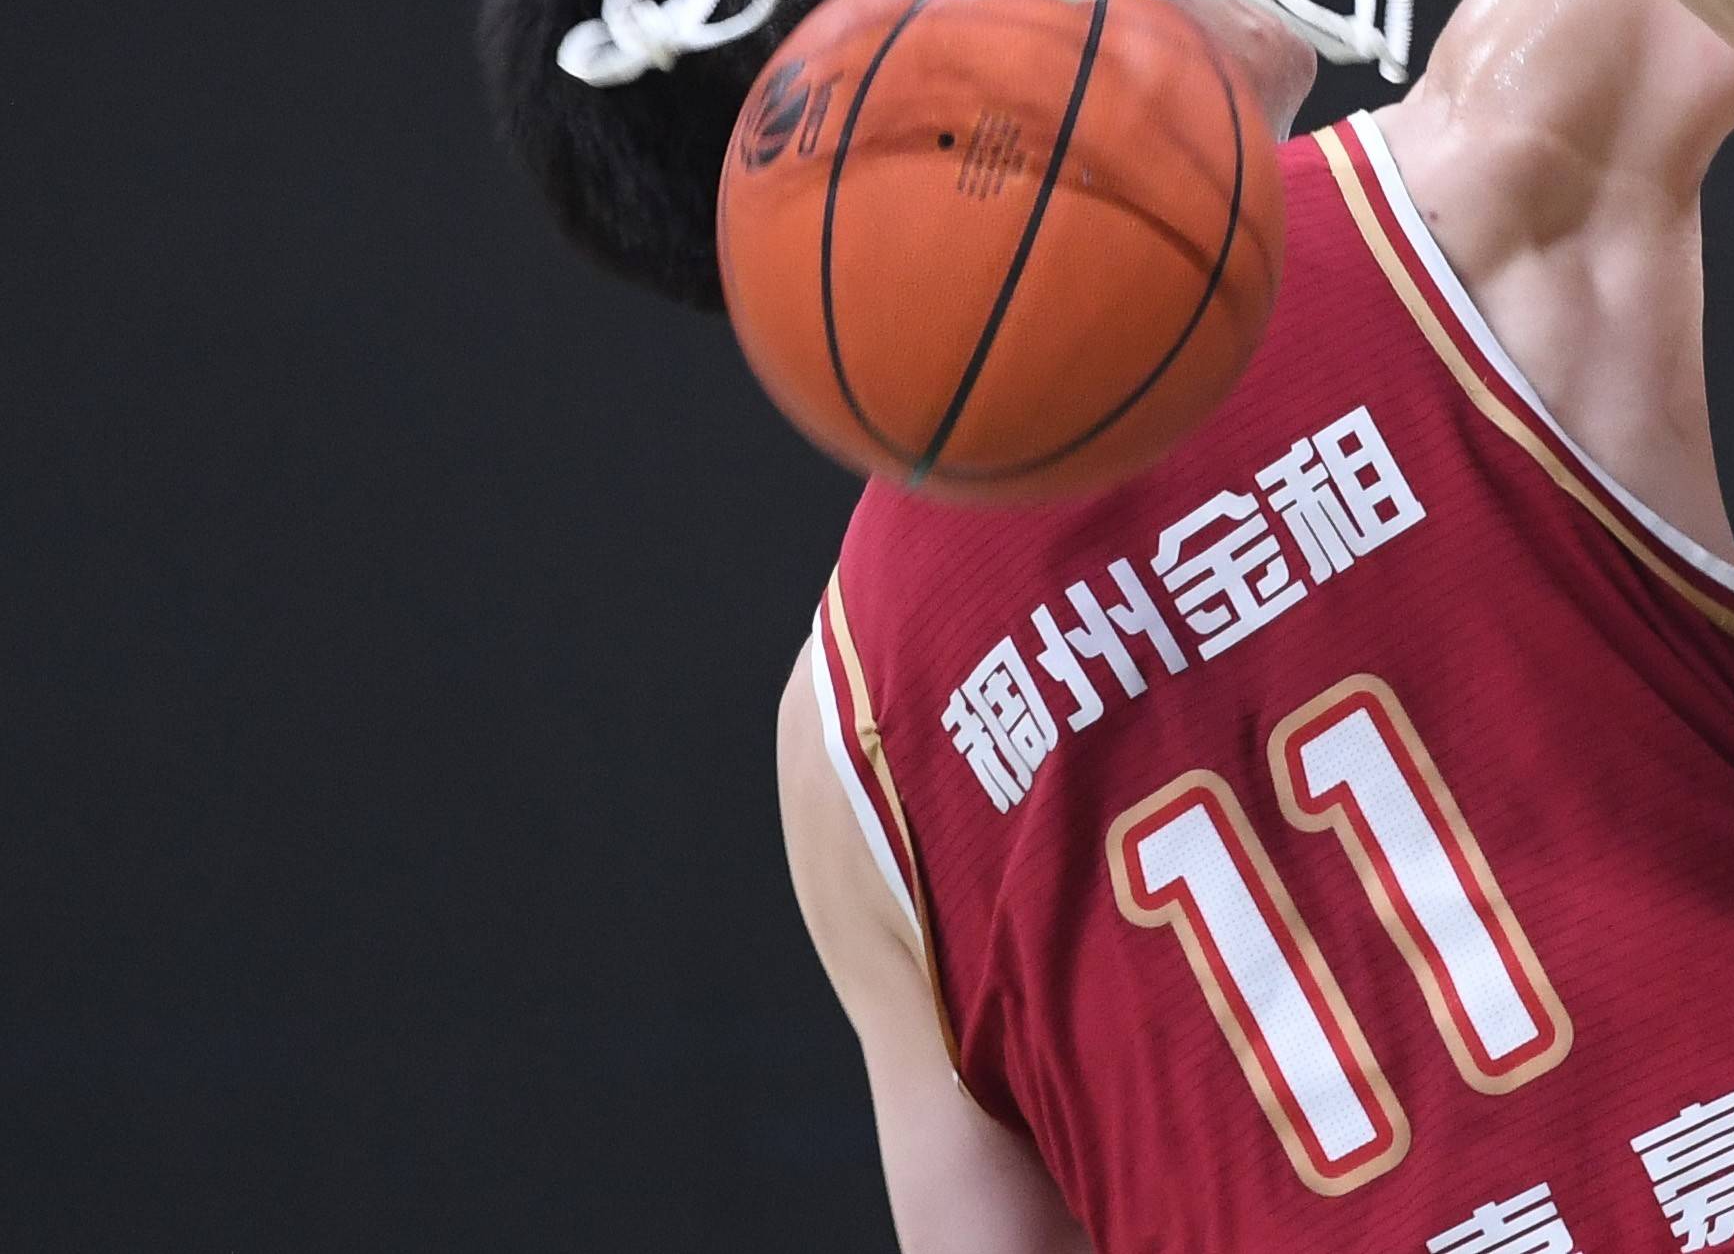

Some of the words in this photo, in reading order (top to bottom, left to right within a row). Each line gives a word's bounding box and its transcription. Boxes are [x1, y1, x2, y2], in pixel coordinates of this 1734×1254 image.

[940, 404, 1428, 815] 稠州金租
[1106, 674, 1573, 1196] 11
